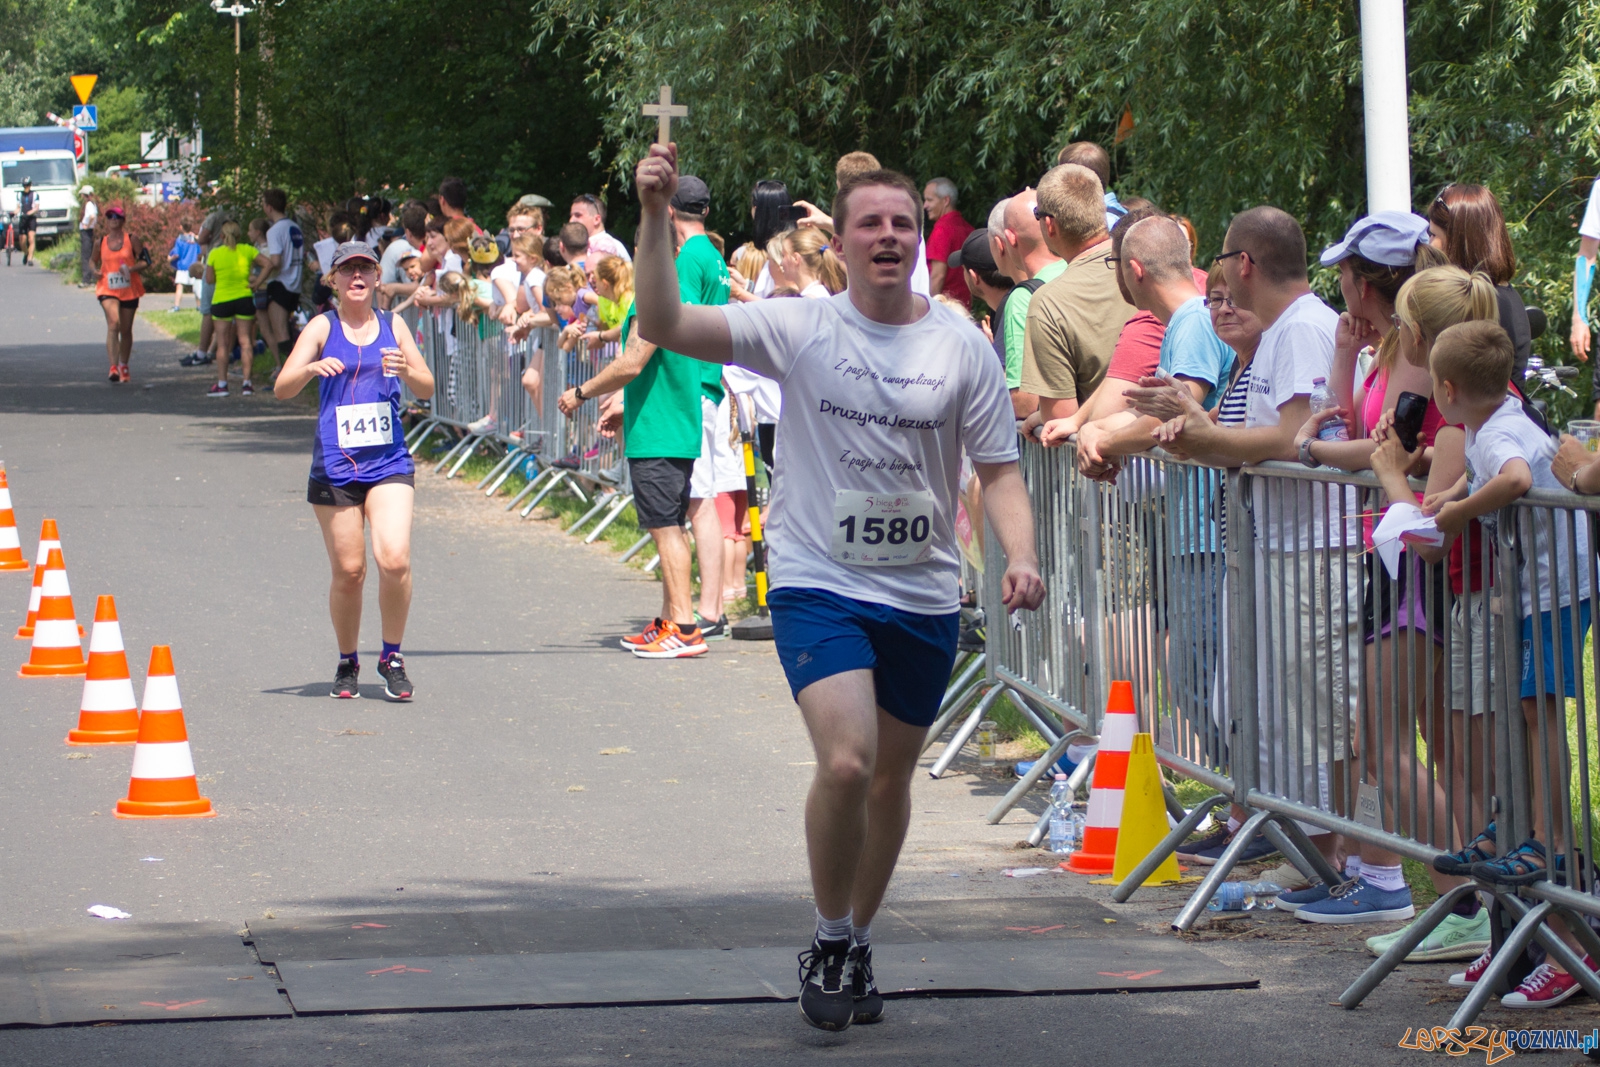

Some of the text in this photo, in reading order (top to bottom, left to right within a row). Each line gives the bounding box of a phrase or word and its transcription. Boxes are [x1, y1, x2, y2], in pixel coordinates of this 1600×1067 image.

[834, 358, 848, 370] Z
[843, 366, 869, 380] pasji
[871, 371, 879, 380] do
[341, 416, 390, 435] 1413
[839, 449, 851, 463] Z
[848, 458, 874, 472] pasji
[875, 458, 885, 470] do
[864, 496, 874, 513] 5
[876, 497, 894, 509] bieg
[839, 515, 930, 545] 1580
